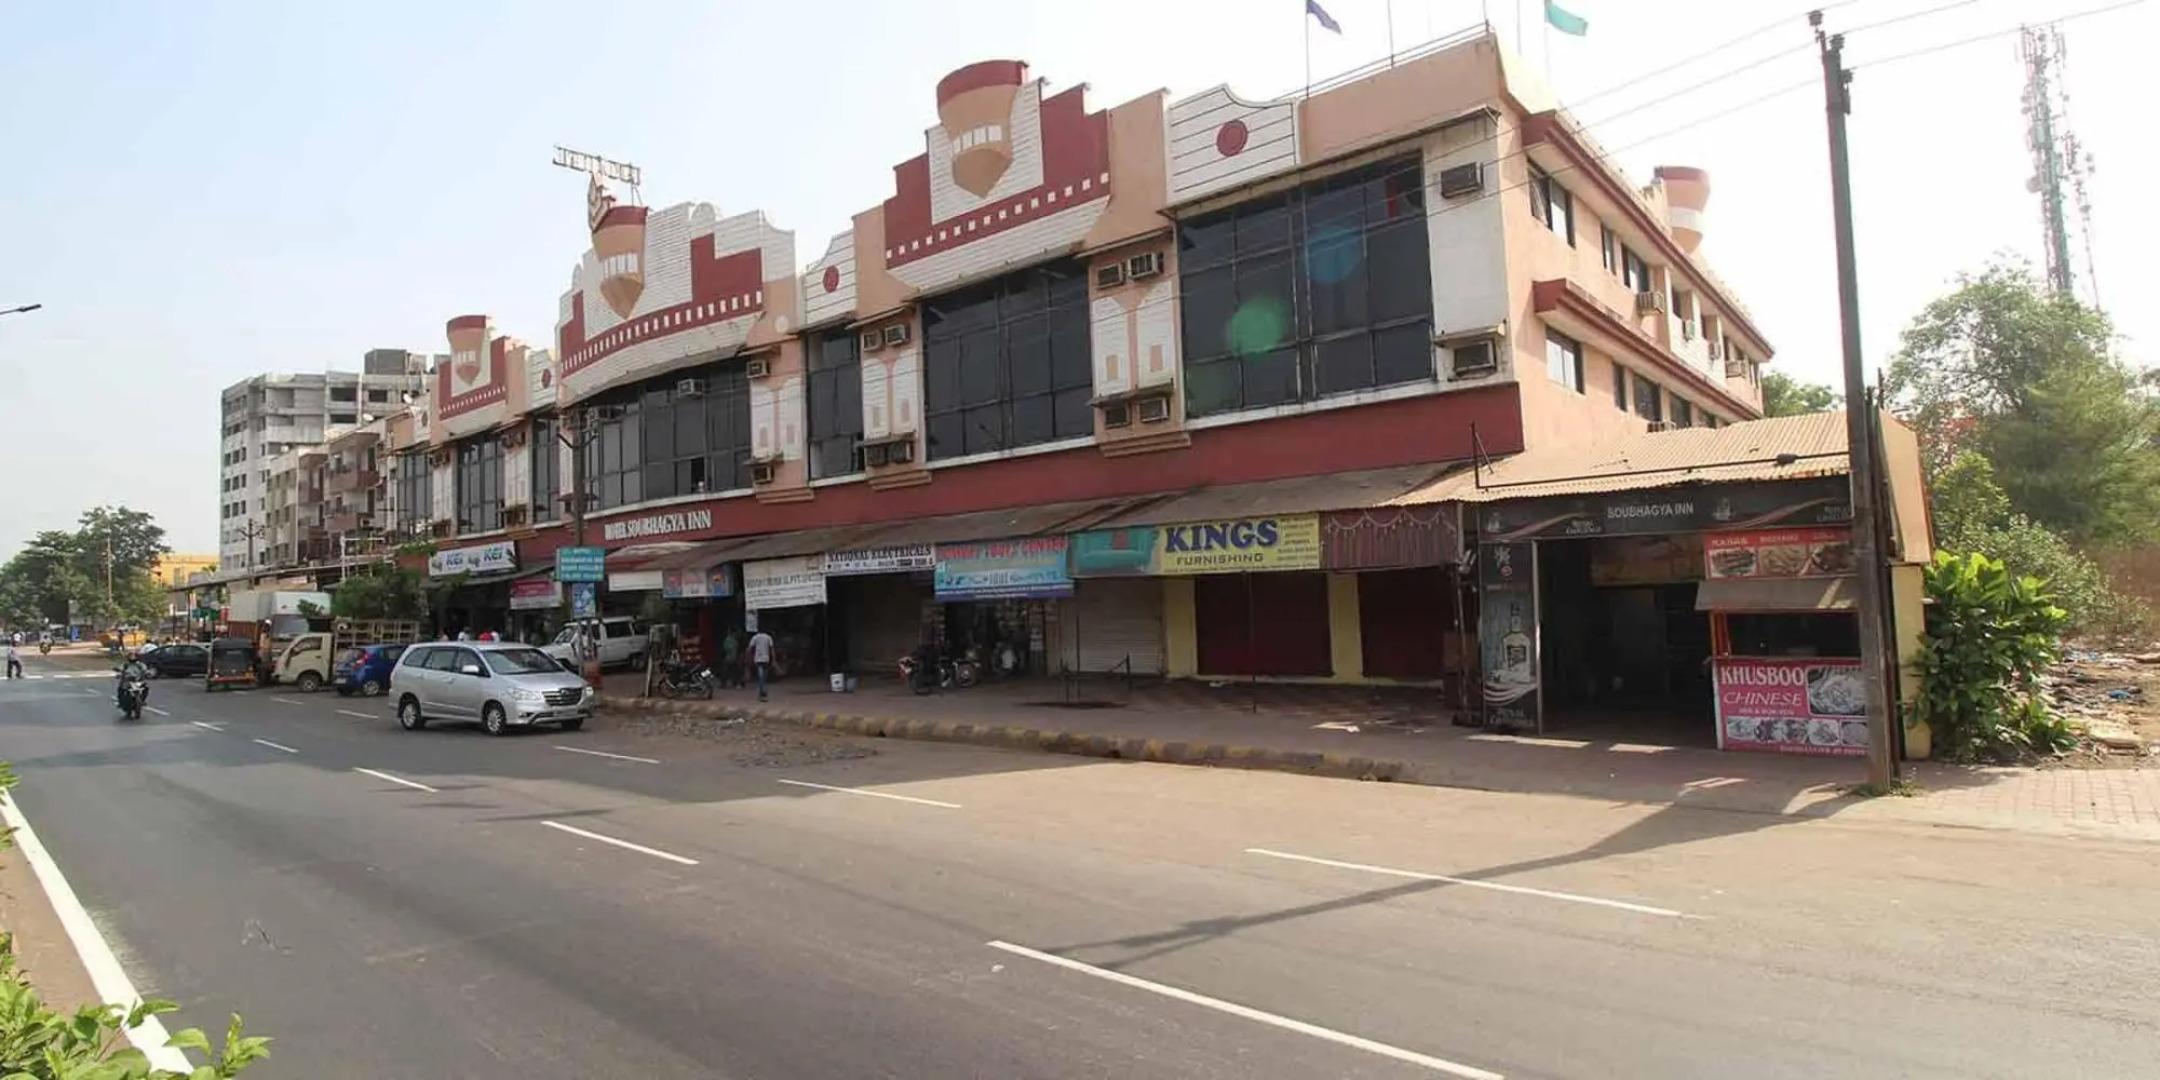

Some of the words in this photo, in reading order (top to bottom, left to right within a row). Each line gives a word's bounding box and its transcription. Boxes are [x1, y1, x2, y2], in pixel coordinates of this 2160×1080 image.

[687, 509, 712, 530] INN
[1607, 504, 1673, 518] SOUBHAGYA
[1674, 502, 1694, 515] INN
[1165, 519, 1278, 553] KINGS
[829, 550, 869, 562] NATIONAL
[870, 543, 932, 560] ELECTRICALS
[1176, 552, 1264, 566] FURNISHING
[1720, 665, 1804, 687] KHUSBOO
[1722, 691, 1802, 706] CHINESE
